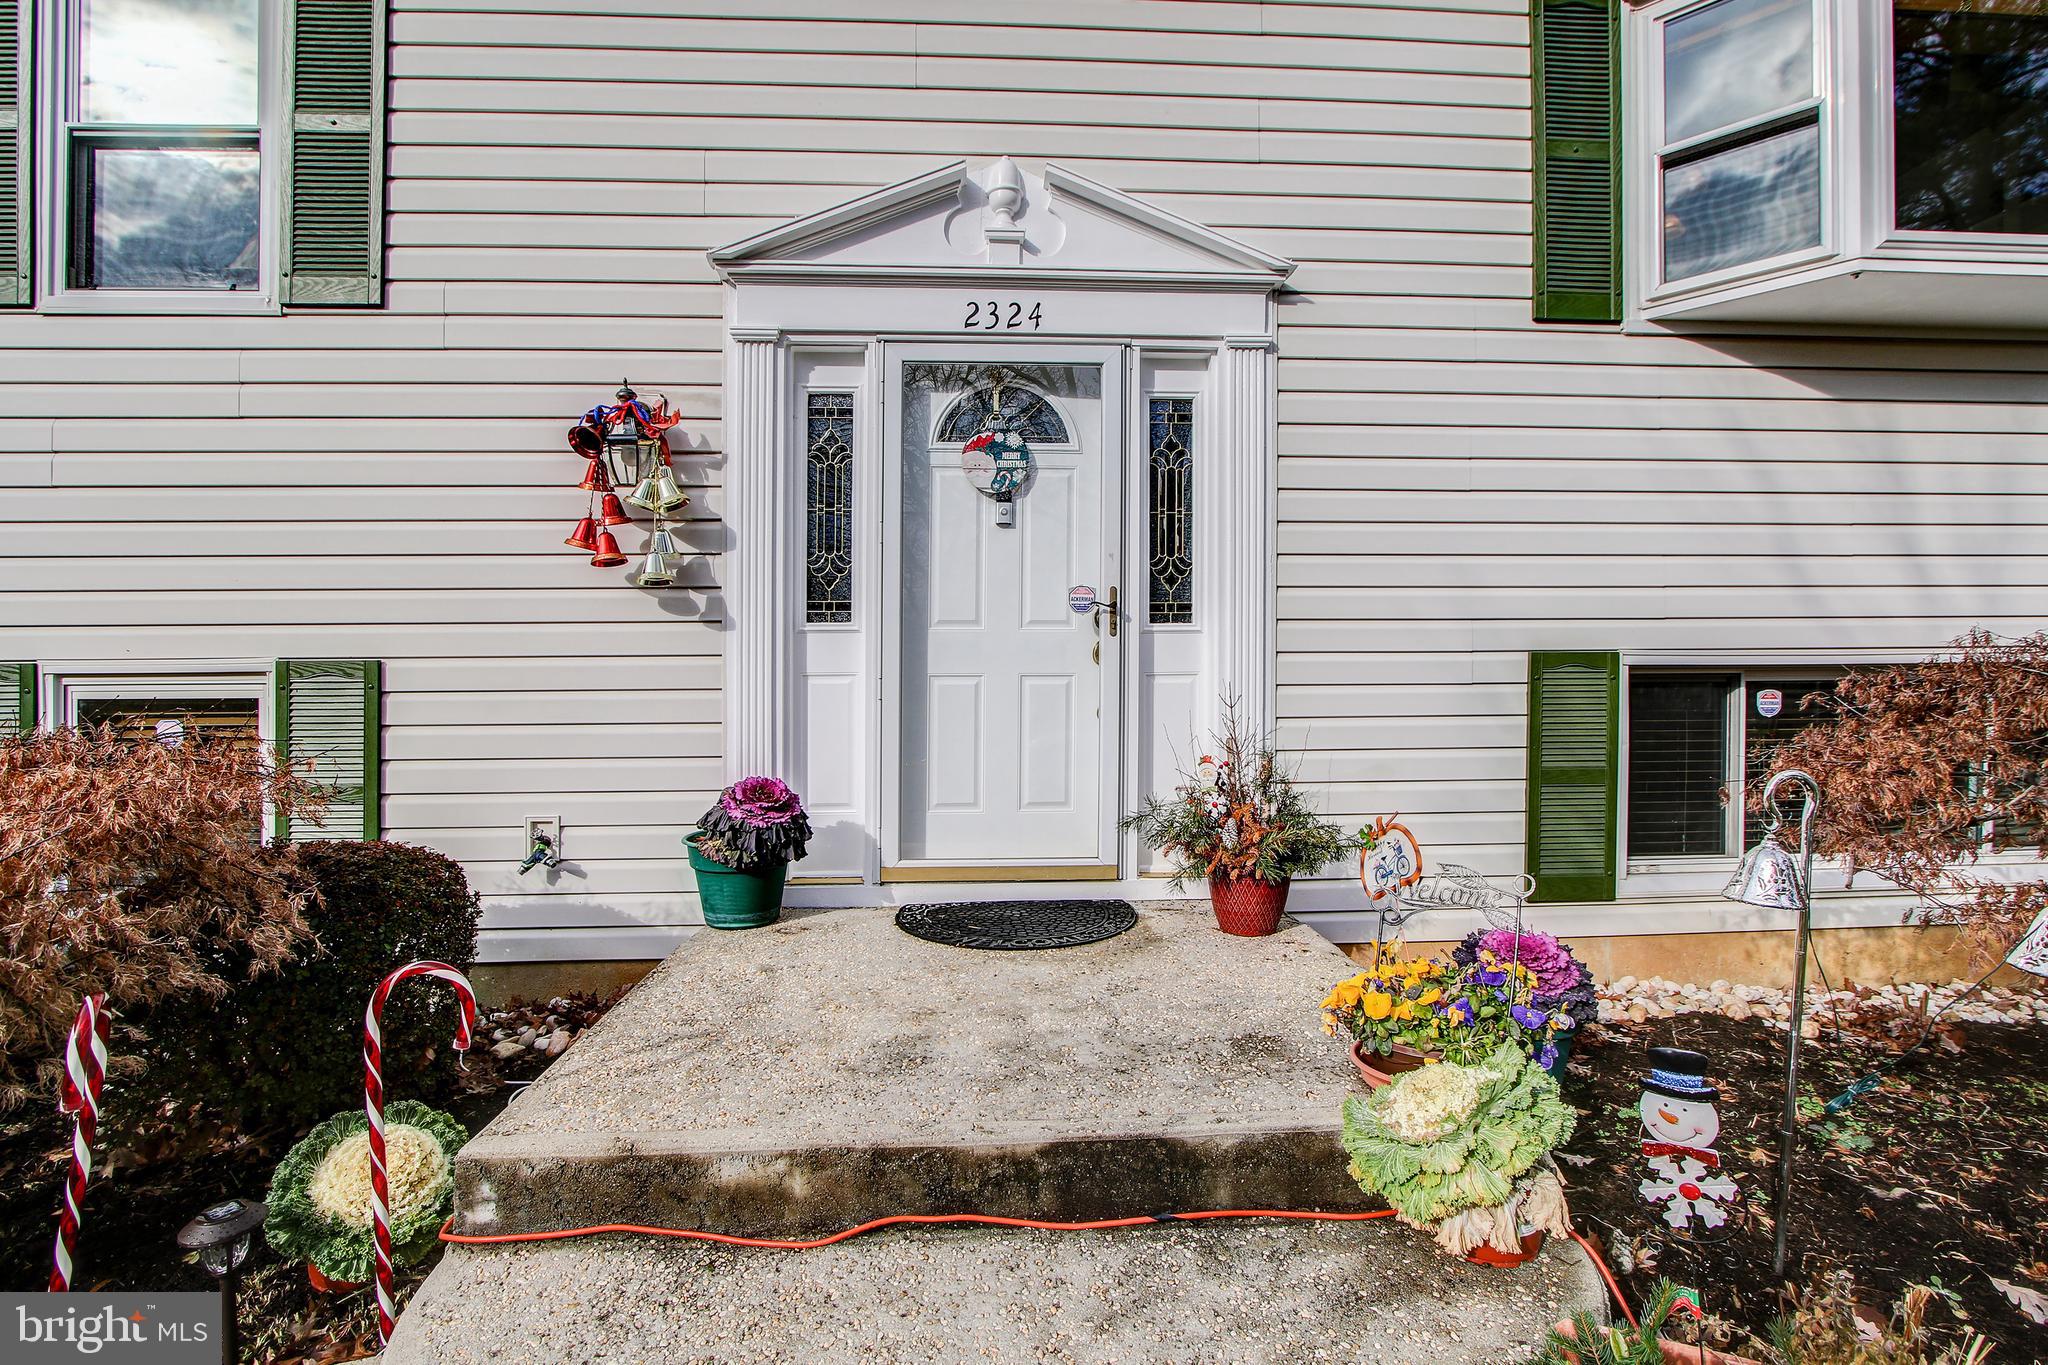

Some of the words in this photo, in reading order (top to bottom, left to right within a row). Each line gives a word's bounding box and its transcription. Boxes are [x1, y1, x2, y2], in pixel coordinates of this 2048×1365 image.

[964, 301, 1042, 331] 2324
[1001, 451, 1021, 460] MERRY
[996, 460, 1027, 468] CHRISTMAS
